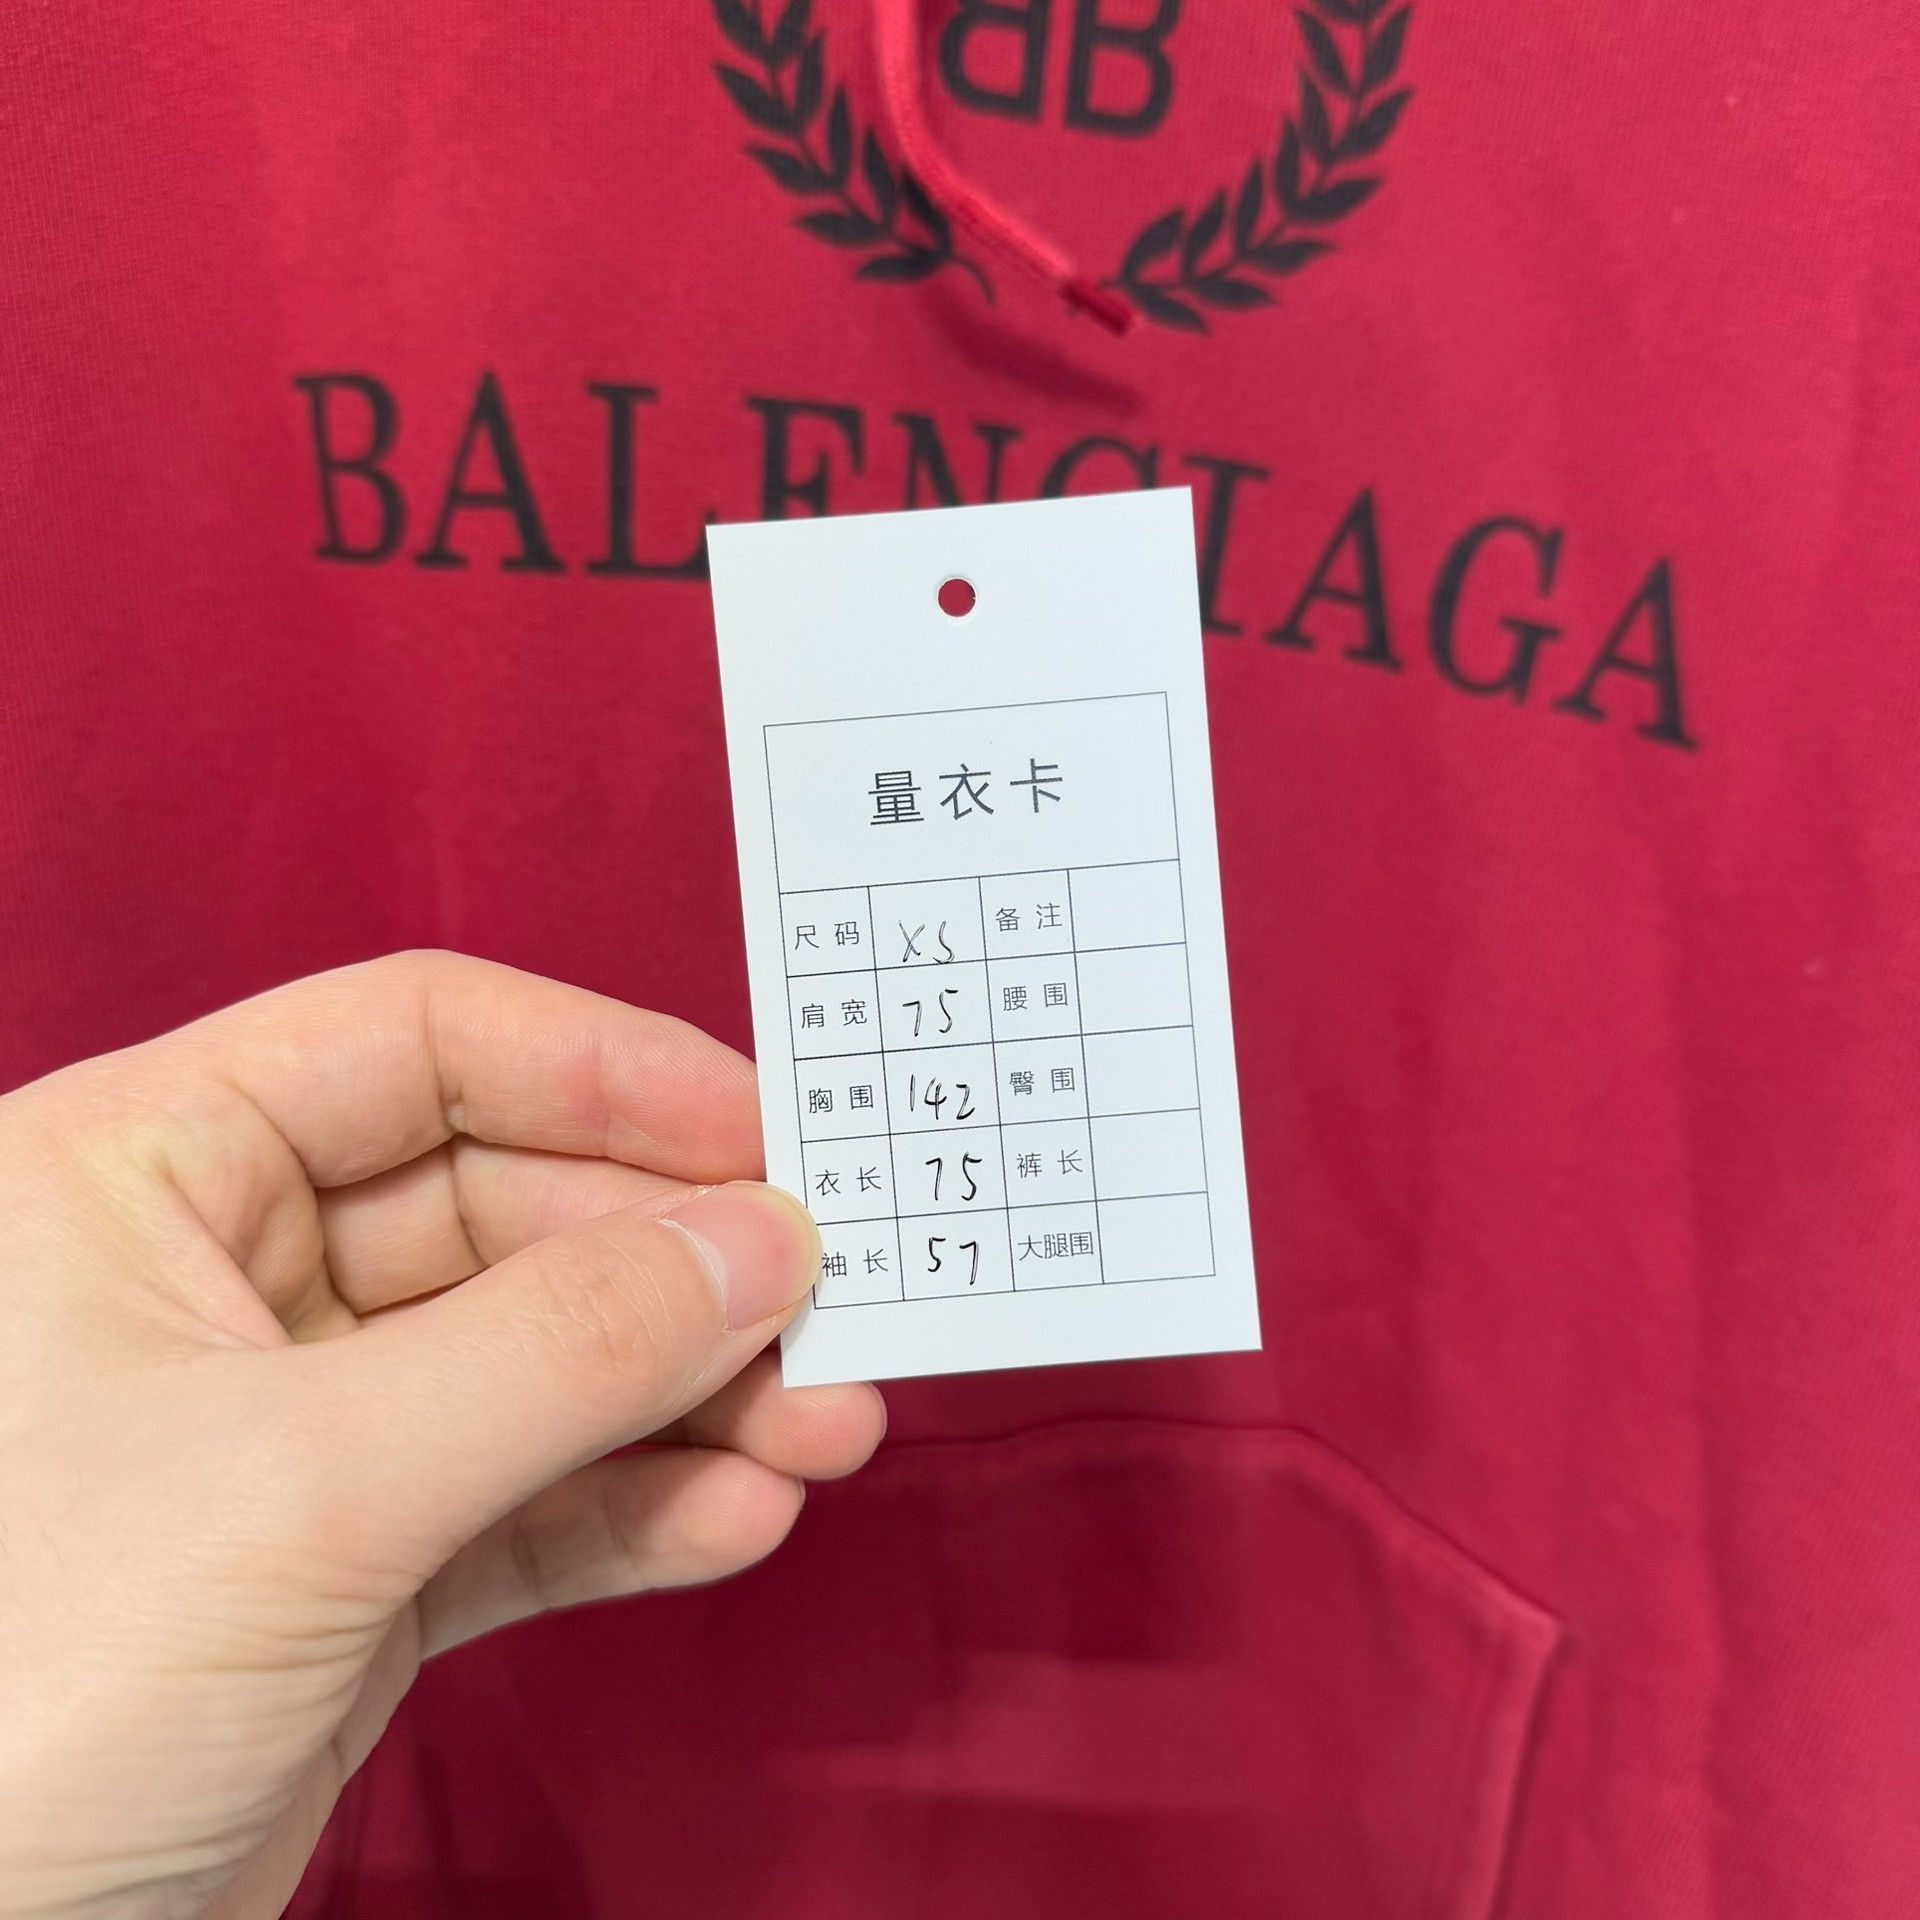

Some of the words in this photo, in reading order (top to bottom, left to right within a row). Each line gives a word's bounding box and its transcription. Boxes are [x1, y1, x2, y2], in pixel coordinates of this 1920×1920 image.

[868, 759, 1062, 825] 量衣卡
[996, 903, 1062, 931] 备注
[795, 922, 859, 949] 尺码
[899, 921, 956, 964] XS
[1003, 983, 1067, 1011] 腰围
[802, 999, 867, 1028] 肩宽
[1010, 1068, 1075, 1096] 臀围
[809, 1085, 873, 1113] 胸围
[910, 1074, 975, 1120] 142
[1017, 1150, 1082, 1178] 裤长
[816, 1167, 881, 1196] 衣长
[1018, 1232, 1093, 1260] 大腿围
[822, 1249, 888, 1277] 袖长
